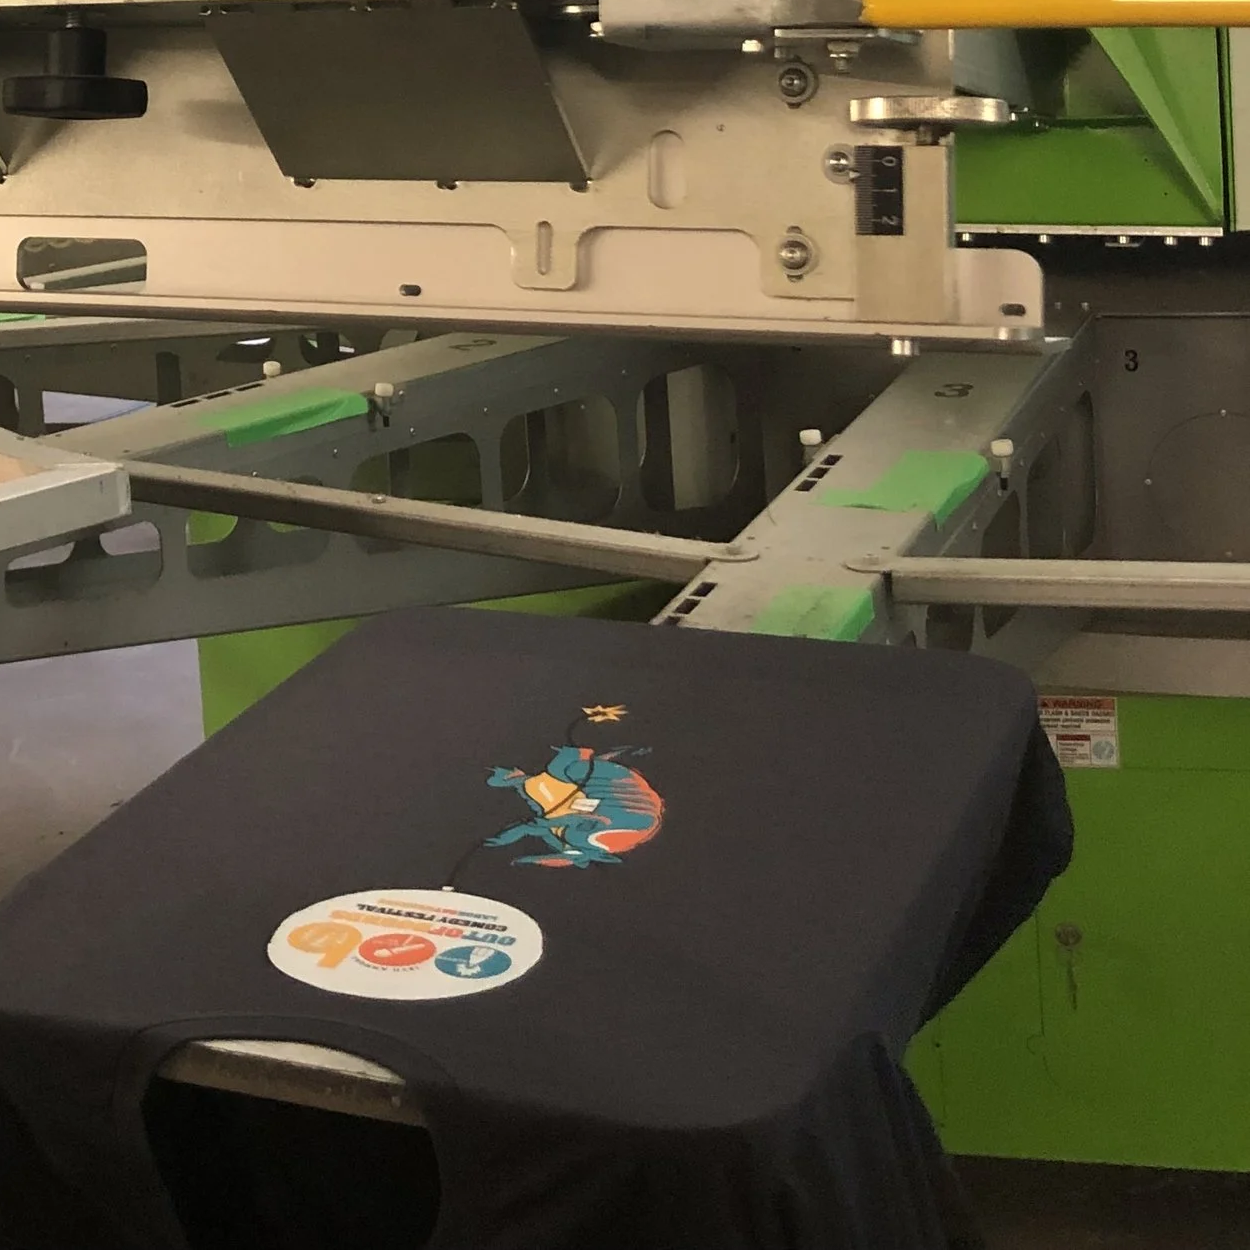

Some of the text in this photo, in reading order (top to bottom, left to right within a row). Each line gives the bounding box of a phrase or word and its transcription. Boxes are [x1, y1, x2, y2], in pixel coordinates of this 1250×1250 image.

[1125, 350, 1139, 372] 3
[934, 383, 975, 398] 3
[356, 903, 437, 921] FESTIVAL
[440, 918, 508, 932] COMEDY
[462, 931, 517, 946] OUT
